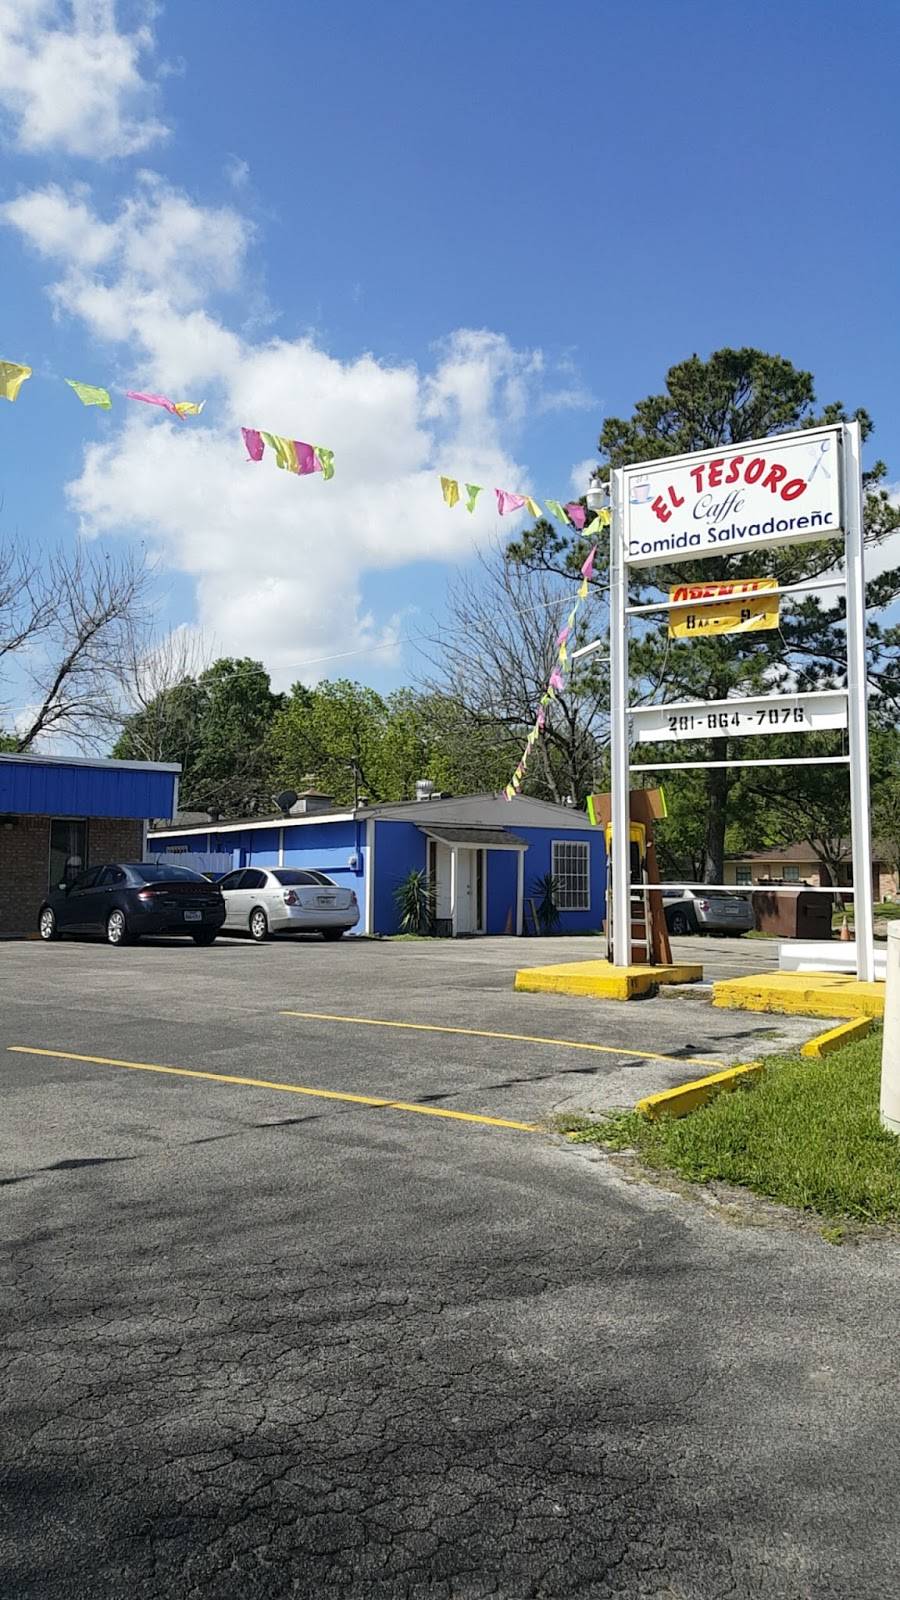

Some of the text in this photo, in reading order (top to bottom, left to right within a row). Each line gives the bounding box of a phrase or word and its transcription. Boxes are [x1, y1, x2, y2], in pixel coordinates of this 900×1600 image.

[651, 456, 807, 523] EL TESORO
[692, 488, 746, 525] Caffe
[629, 531, 701, 556] Comida
